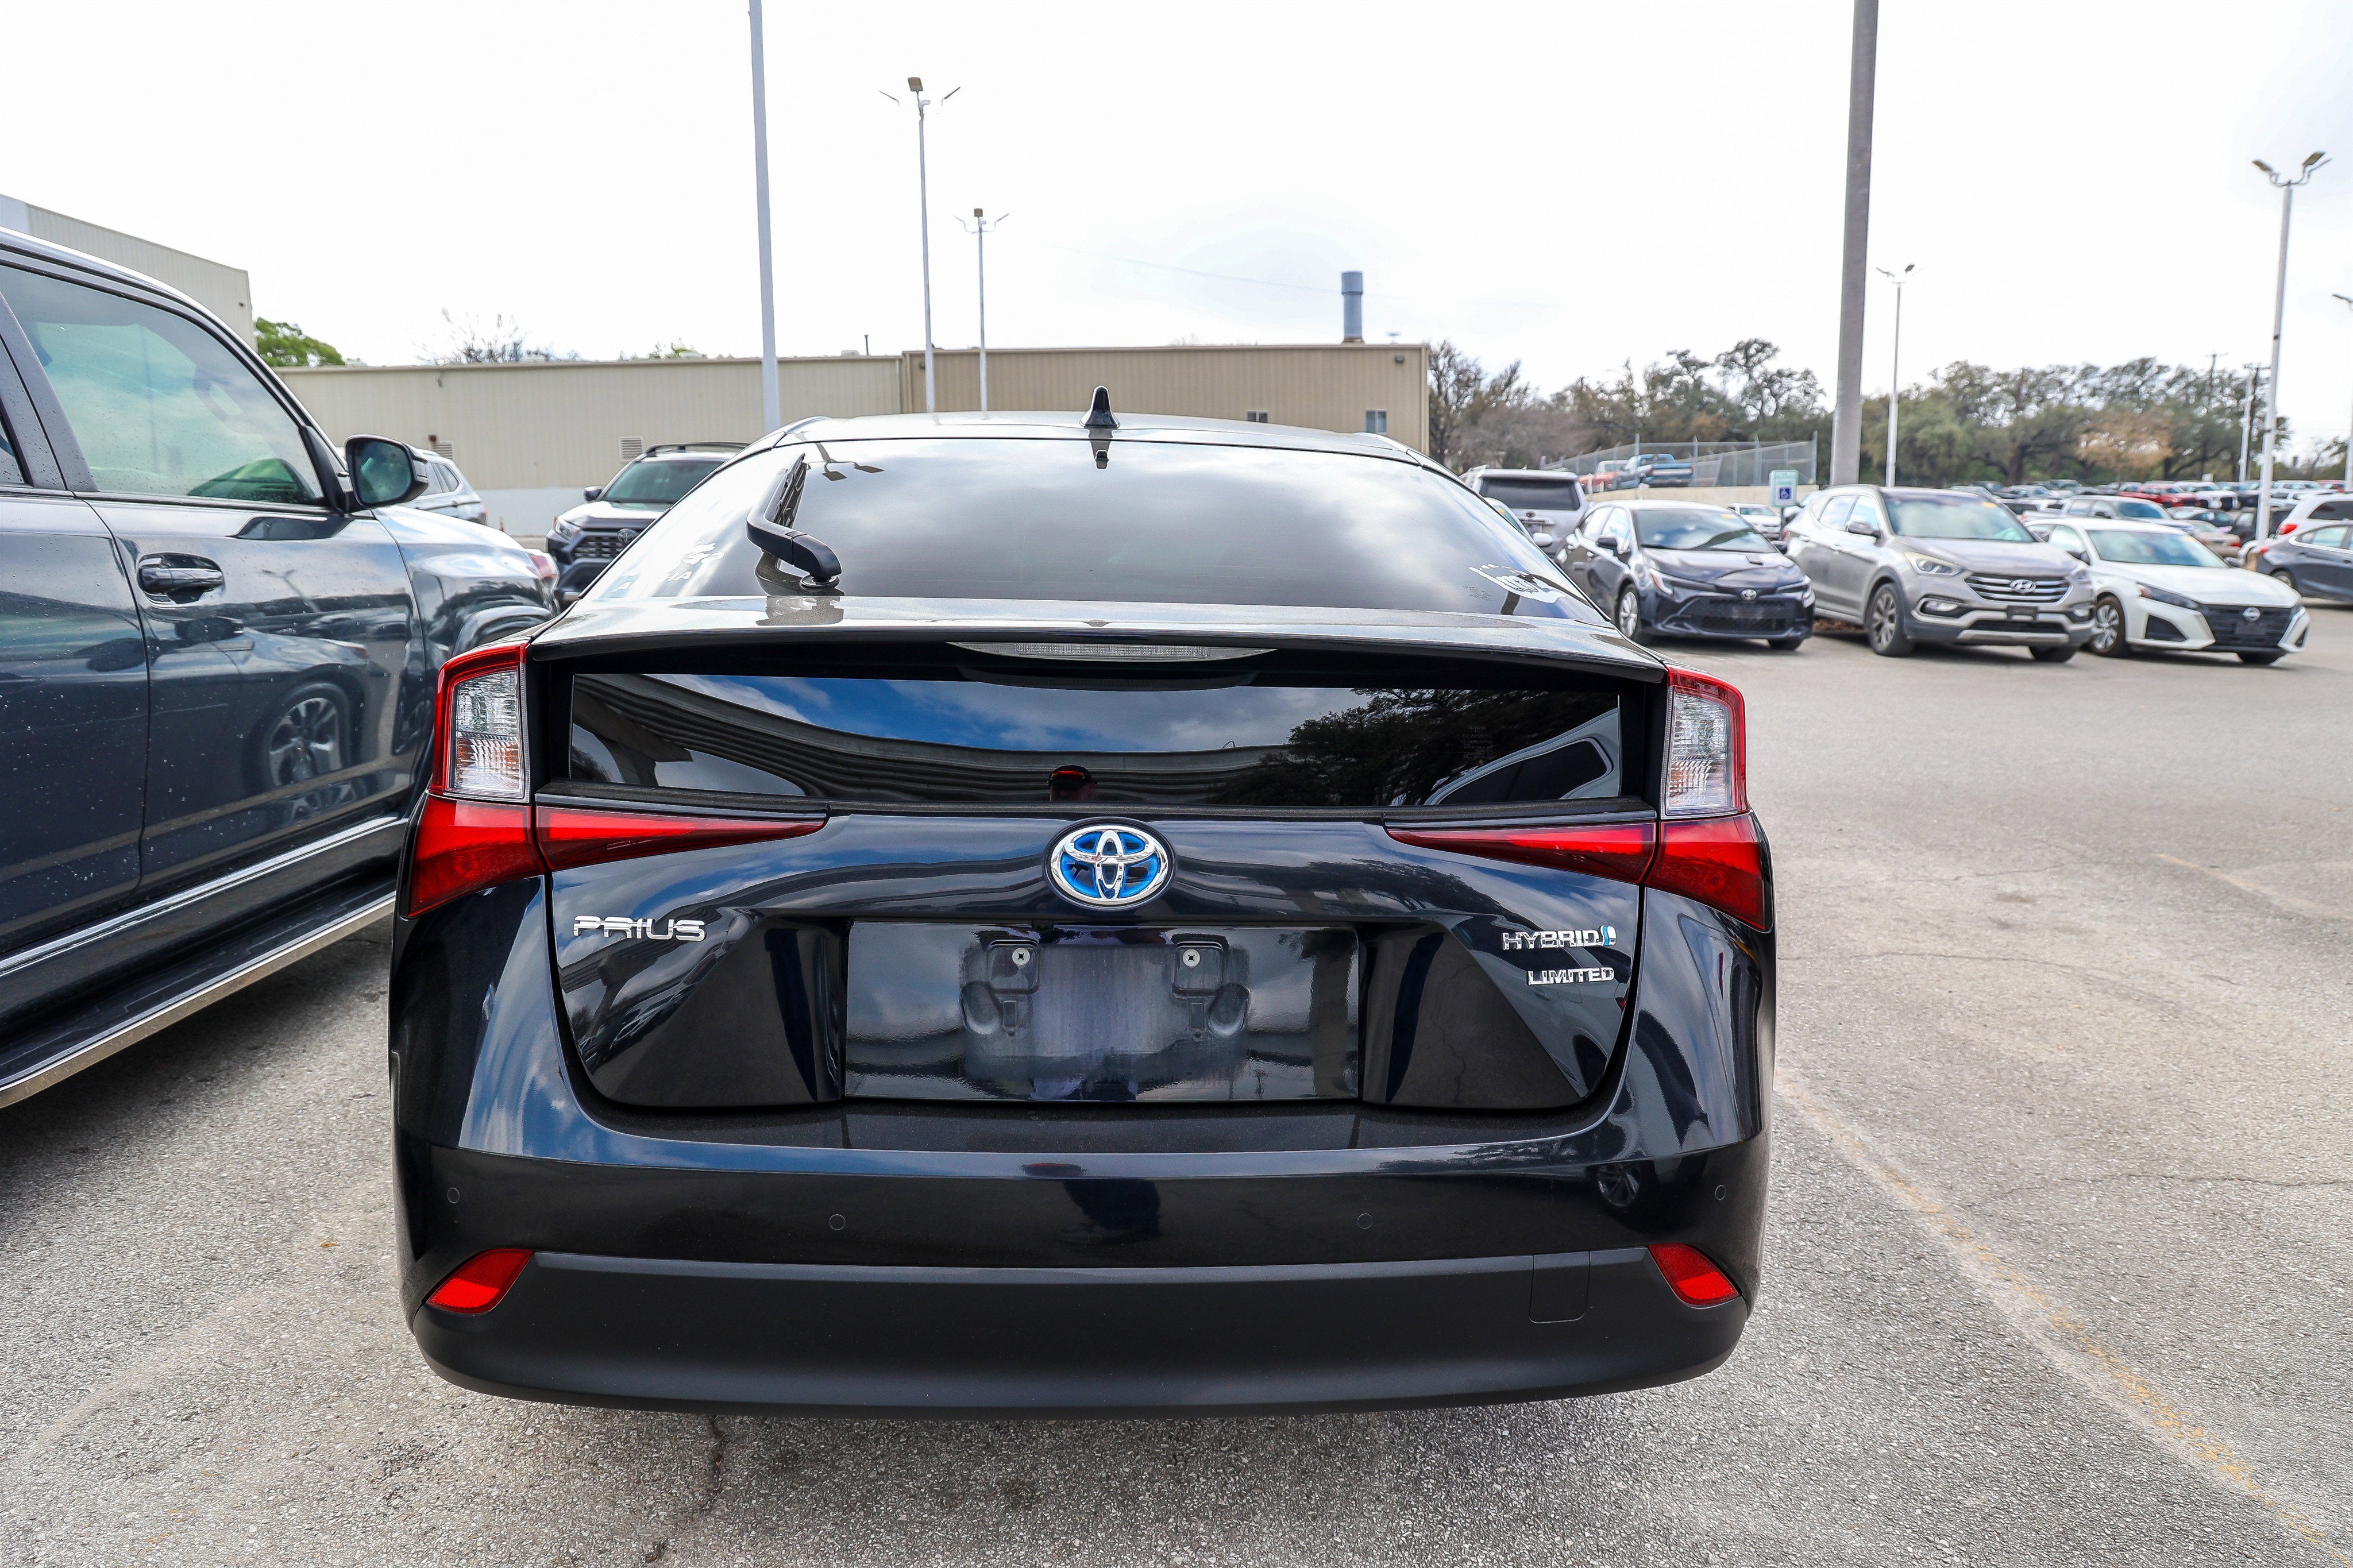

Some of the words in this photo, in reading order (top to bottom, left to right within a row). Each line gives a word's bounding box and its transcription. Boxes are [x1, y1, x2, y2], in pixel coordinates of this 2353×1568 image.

[573, 916, 707, 941] PRIUS
[1502, 929, 1600, 951] HYBRID
[1527, 967, 1615, 986] LIMITED
